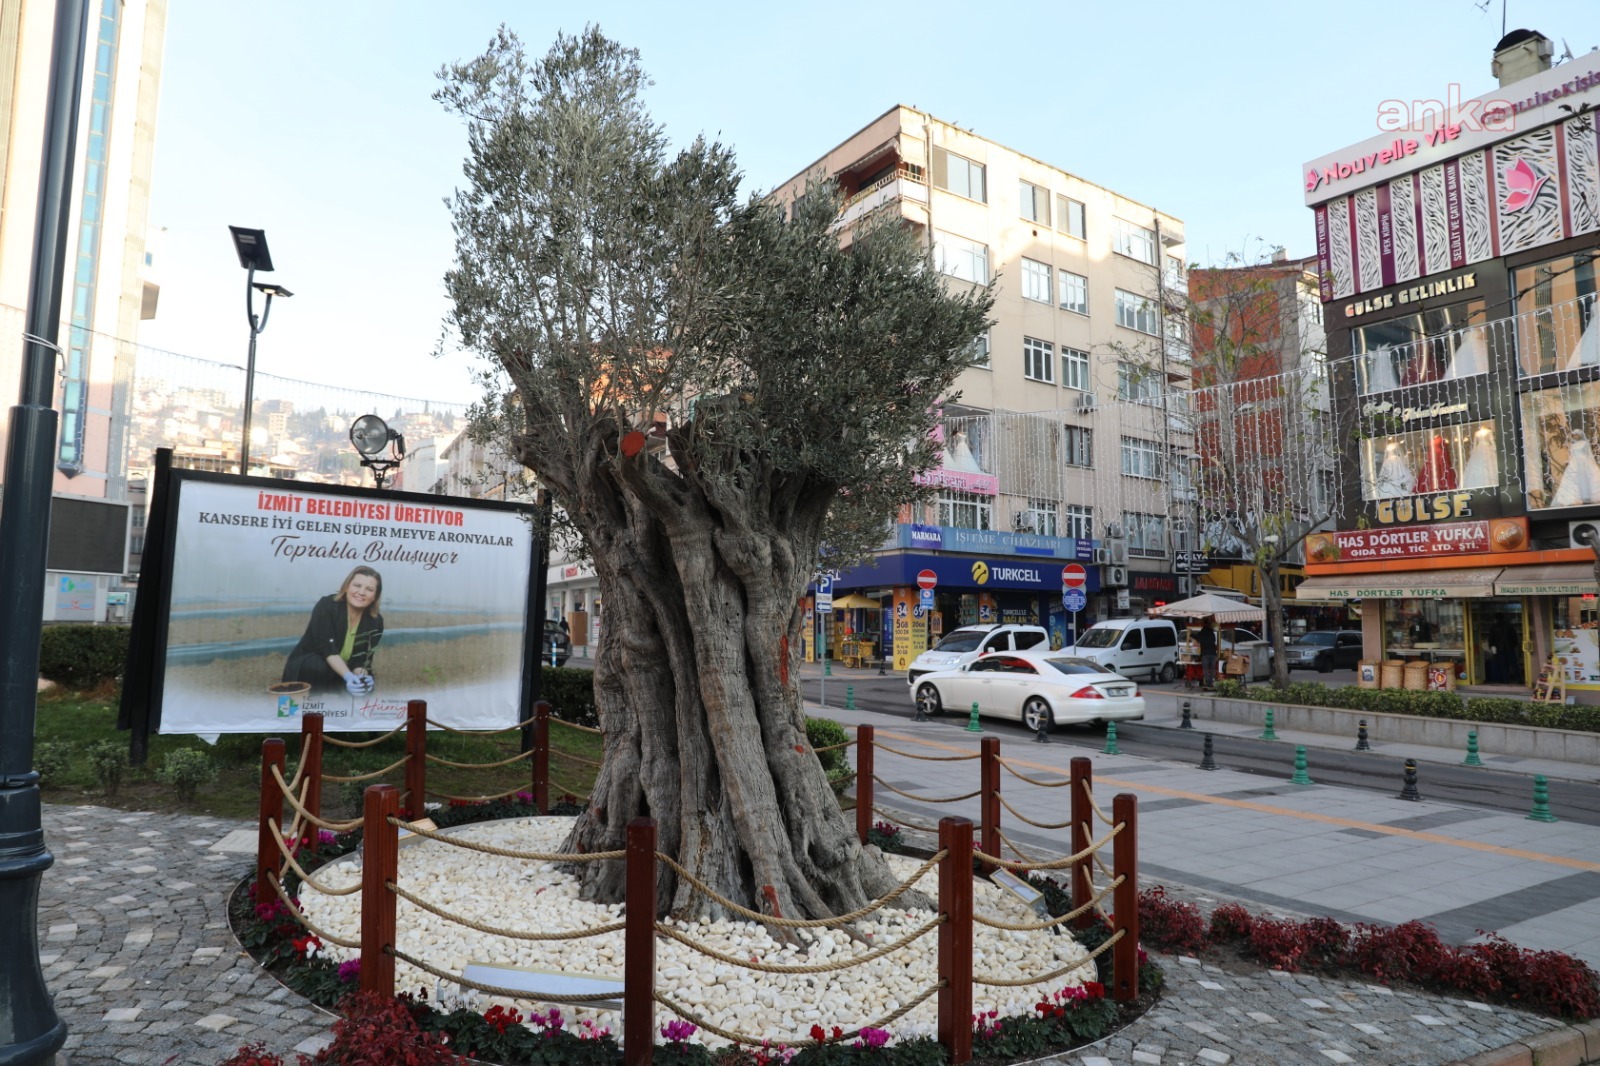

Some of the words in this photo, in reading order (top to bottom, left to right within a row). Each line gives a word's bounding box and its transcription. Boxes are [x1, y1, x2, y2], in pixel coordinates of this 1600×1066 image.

[1323, 139, 1420, 185] Nouvelle
[1425, 123, 1462, 147] vie
[1447, 165, 1457, 190] BAKIM
[1448, 190, 1460, 219] ÇATLAK
[1450, 219, 1460, 230] VE
[1451, 231, 1461, 262] SELÜLİT
[258, 491, 303, 513] İZMİT
[306, 498, 391, 521] BELEDİYESİ
[394, 504, 464, 527] ÜRETİYOR
[198, 512, 269, 528] KANSERE
[272, 515, 293, 530] İYİ
[296, 520, 342, 534] GELEN
[344, 522, 387, 537] SÜPER
[390, 528, 435, 541] MEYVE
[438, 532, 514, 547] ARONYALAR
[911, 530, 941, 542] MARMARA
[956, 530, 996, 544] İŞİTME
[1338, 536, 1364, 549] HAS
[1369, 531, 1430, 546] DÖRTLER
[1434, 526, 1484, 542] YUFKA
[271, 535, 360, 563] Toprakla
[363, 540, 459, 570] Buluşuyor
[1351, 548, 1377, 557] GIDA
[1380, 546, 1404, 555] SAN.
[1409, 544, 1427, 553] TİC.
[1432, 543, 1454, 552] LTD.
[991, 567, 1042, 583] TURKCELL
[1329, 589, 1349, 597] HAS
[1356, 588, 1403, 597] DÖRTLER
[1410, 588, 1447, 597] YUFKA
[897, 605, 908, 616] 34
[913, 606, 924, 616] 69
[302, 702, 325, 710] İZMİT
